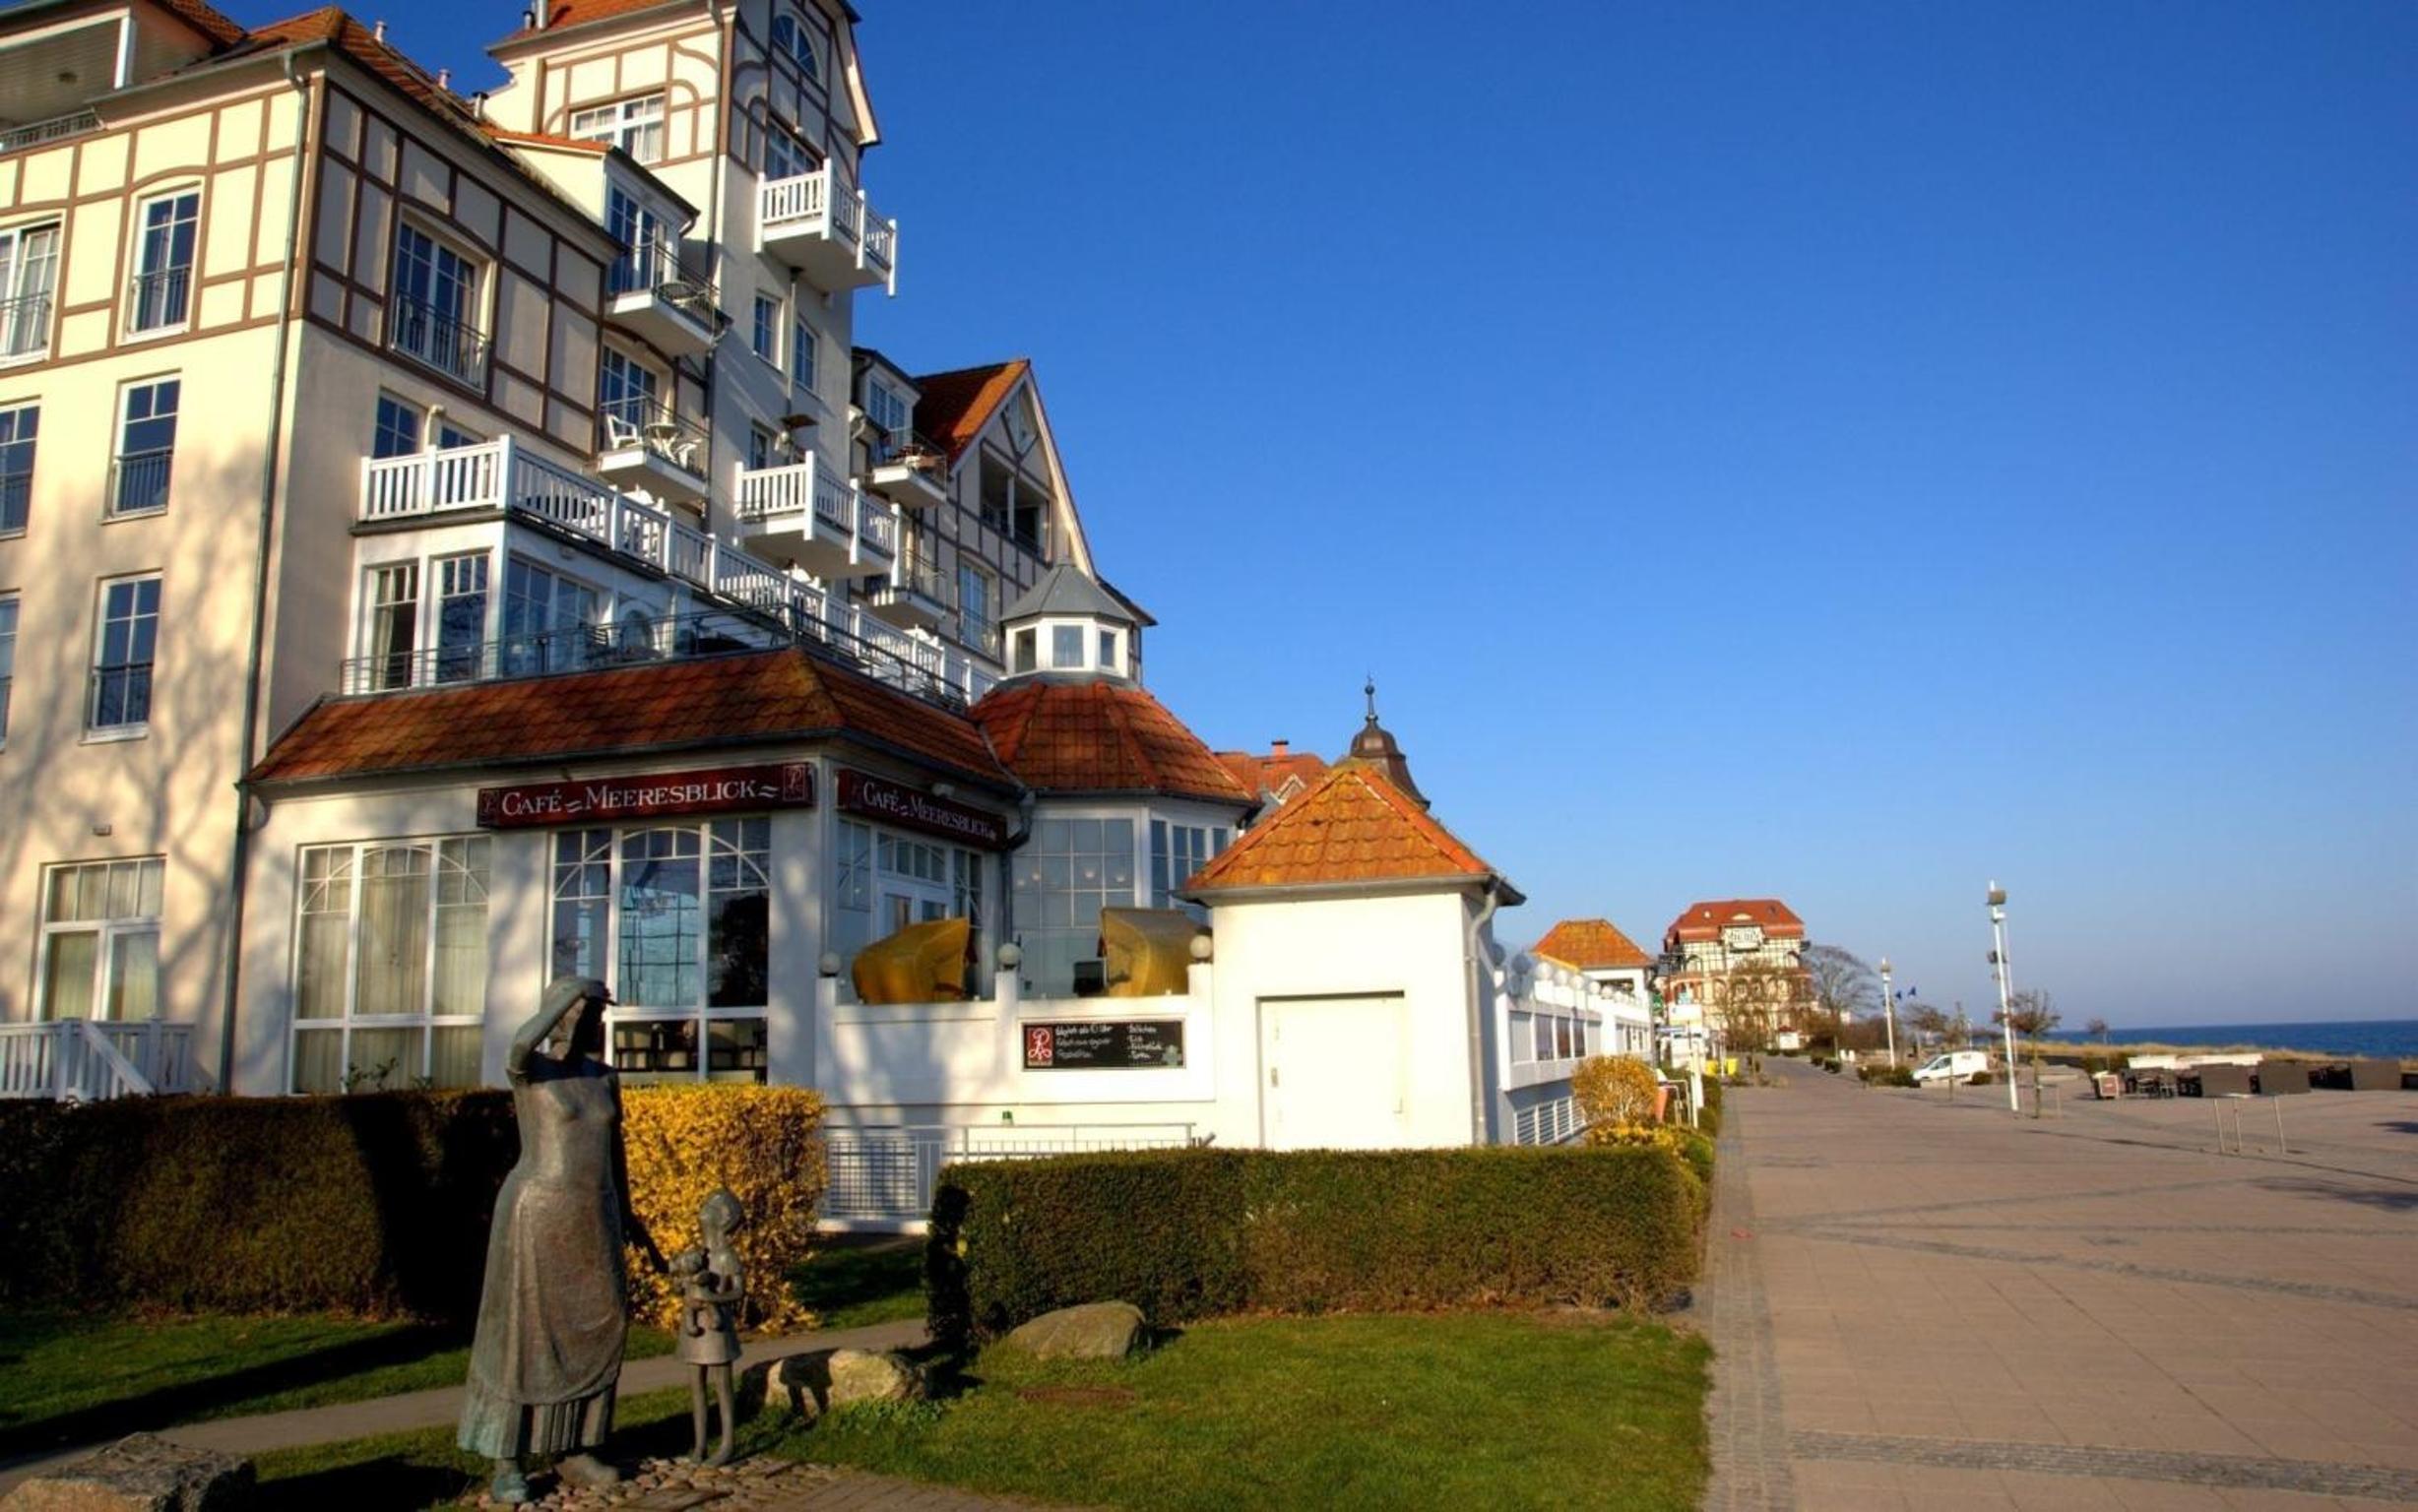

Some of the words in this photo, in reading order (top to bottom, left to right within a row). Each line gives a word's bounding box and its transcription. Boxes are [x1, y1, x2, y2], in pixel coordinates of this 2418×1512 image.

[501, 788, 562, 816] CAFÉ
[585, 779, 757, 810] MEERESBLICK
[862, 781, 901, 813] CAFÉ
